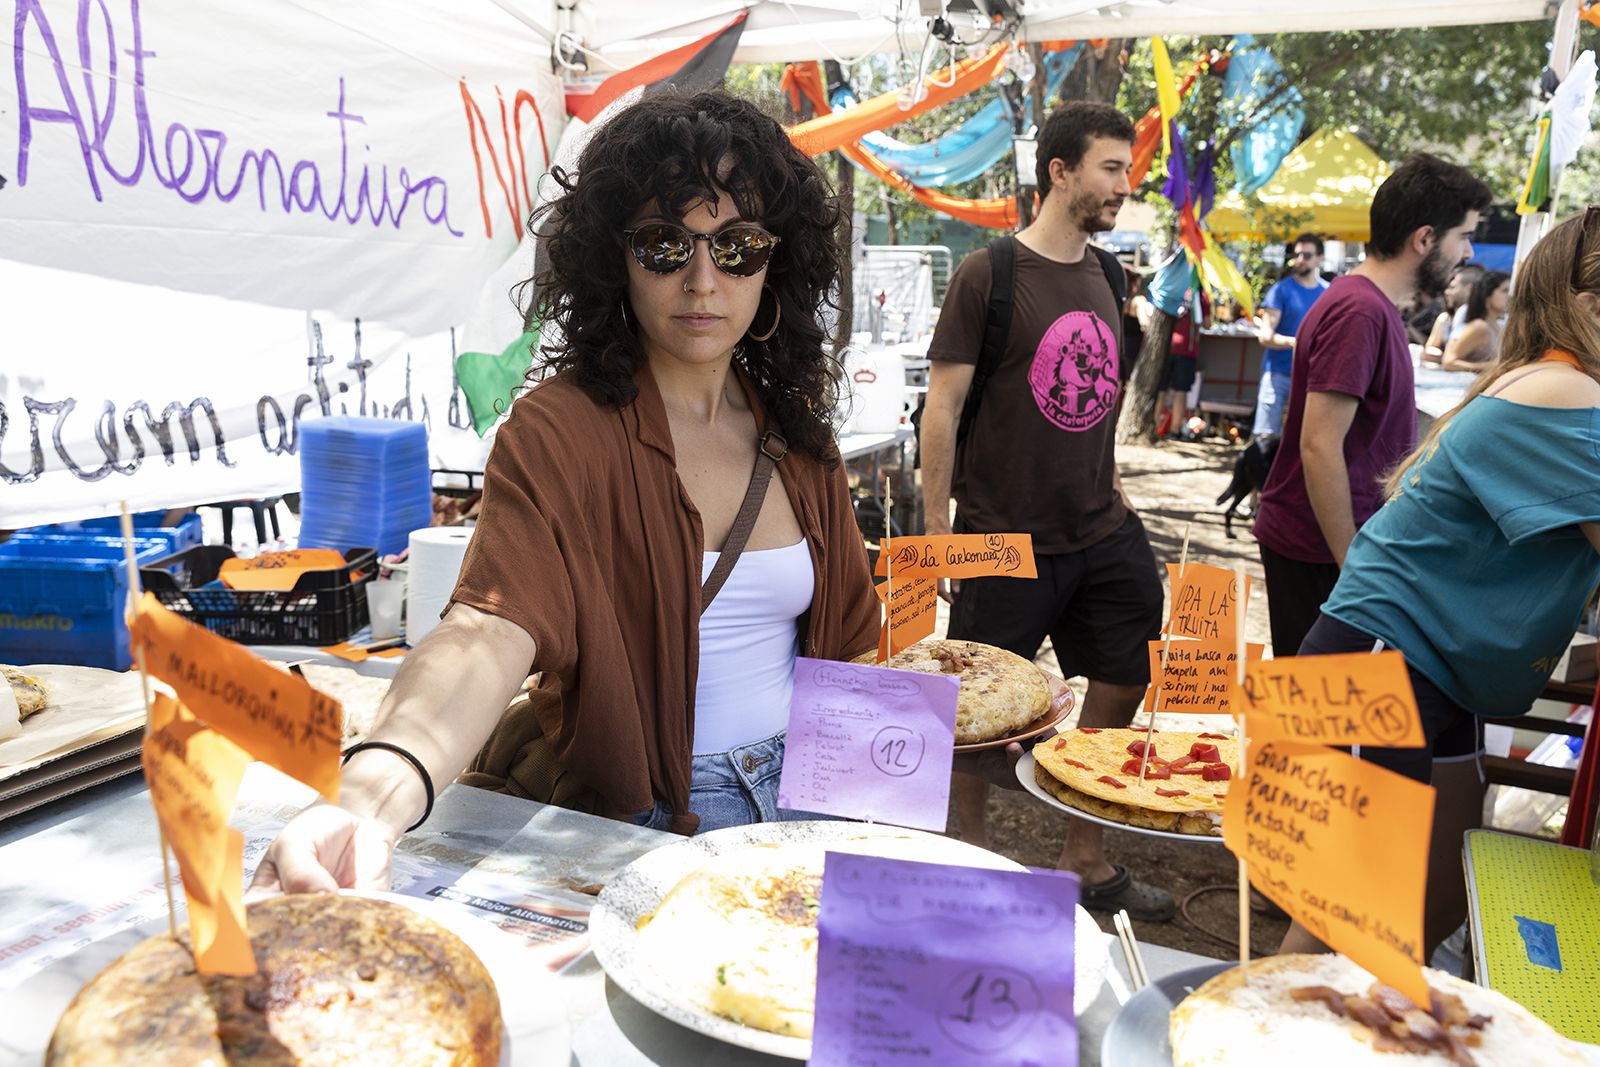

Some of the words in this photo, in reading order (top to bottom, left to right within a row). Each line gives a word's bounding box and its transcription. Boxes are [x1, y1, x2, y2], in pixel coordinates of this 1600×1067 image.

[14, 0, 464, 237] Alternativa
[0, 394, 238, 484] rem
[989, 534, 1000, 547] 10
[945, 545, 1000, 566] Carbonara
[1208, 591, 1230, 617] LA
[1156, 648, 1191, 664] Tuita
[1202, 696, 1216, 706] del
[880, 739, 908, 769] 12
[473, 897, 511, 913] Major
[510, 907, 586, 932] Alternativa
[952, 972, 1021, 1032] 13
